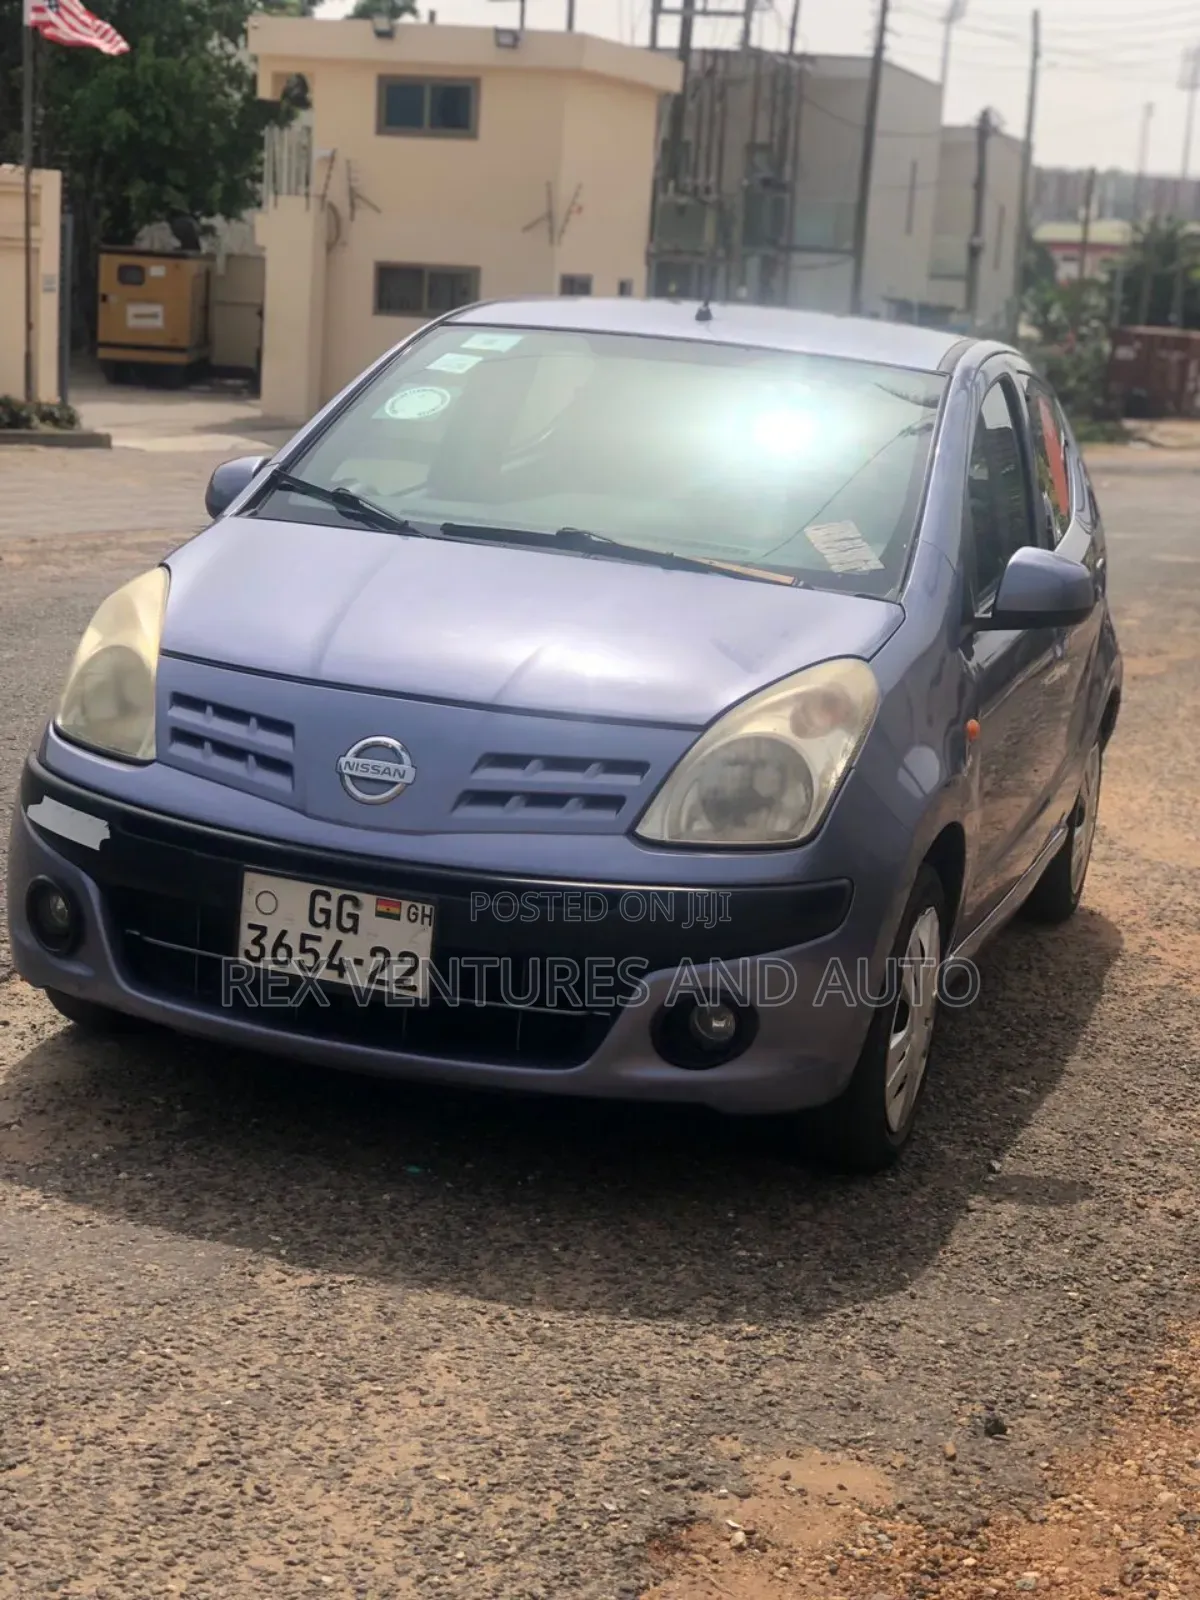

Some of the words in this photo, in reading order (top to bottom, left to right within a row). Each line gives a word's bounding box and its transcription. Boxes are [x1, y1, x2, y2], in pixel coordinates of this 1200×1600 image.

[343, 760, 407, 780] NISSAN
[307, 888, 361, 936] GG
[406, 903, 434, 928] GH
[243, 922, 420, 993] 3654-22
